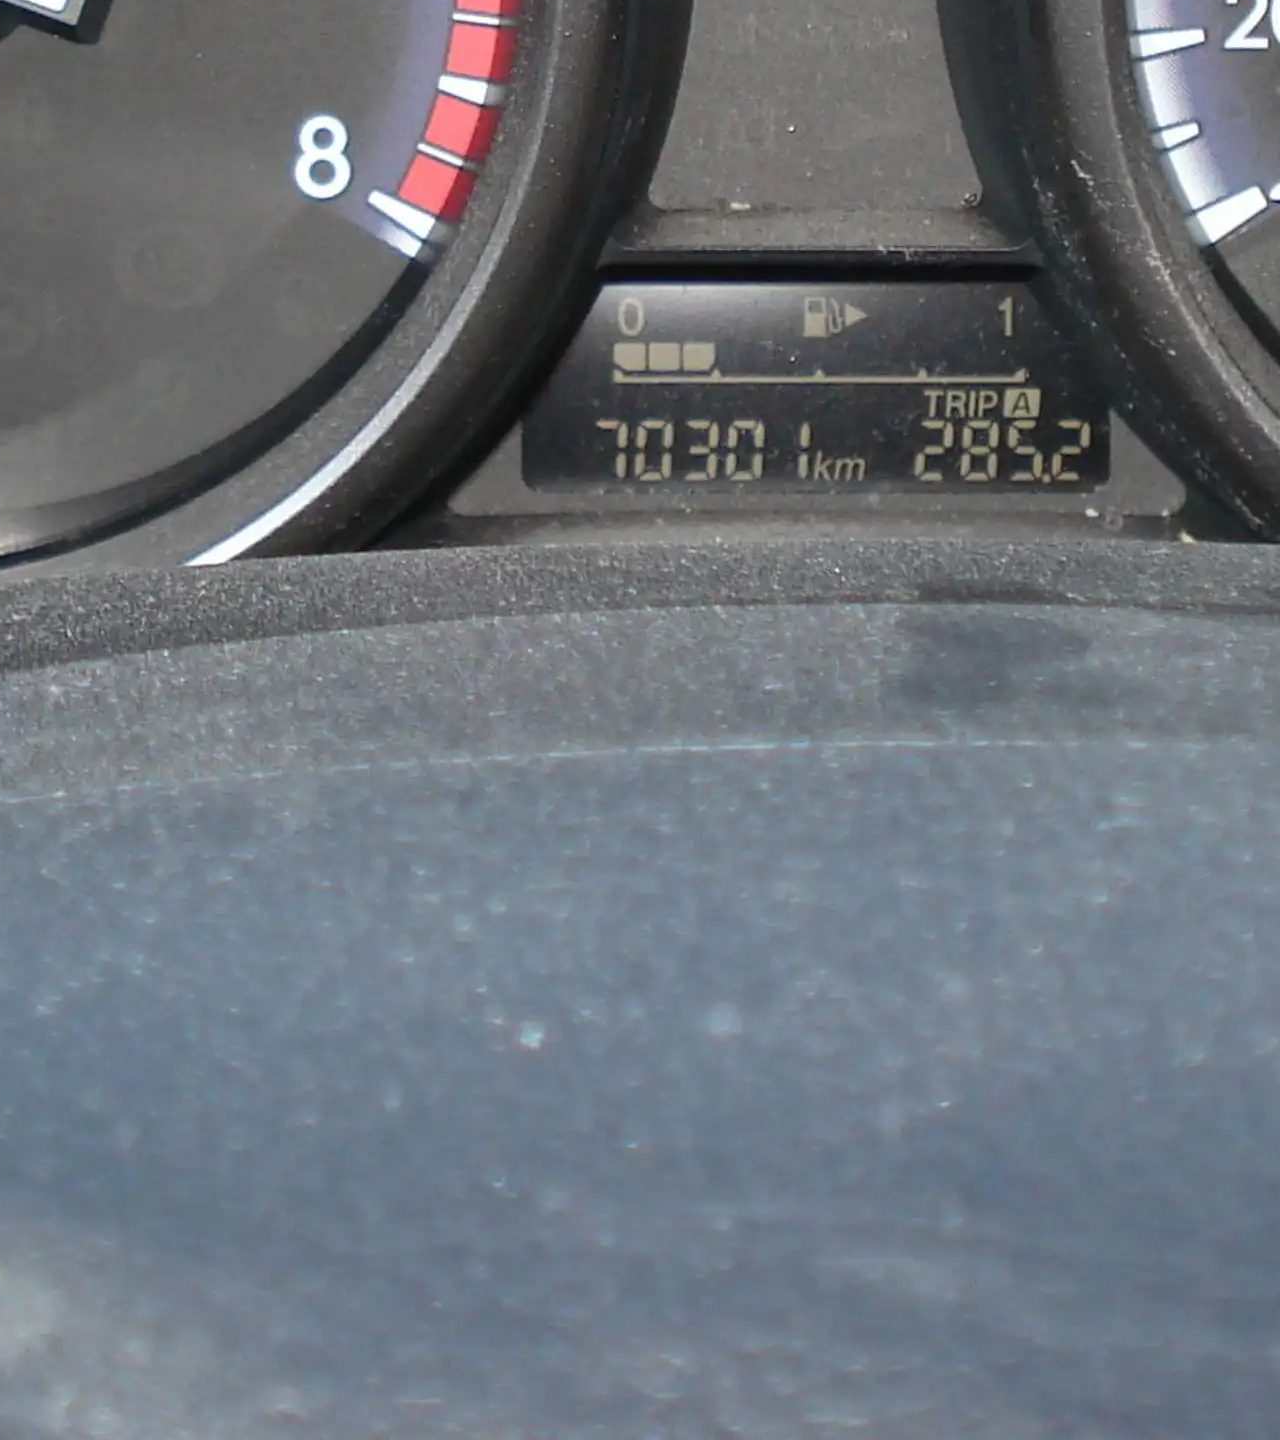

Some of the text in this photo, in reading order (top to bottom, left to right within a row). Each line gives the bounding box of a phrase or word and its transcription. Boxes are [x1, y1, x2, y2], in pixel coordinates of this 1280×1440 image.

[294, 115, 351, 199] 8
[617, 299, 647, 337] 0
[997, 296, 1013, 337] 1
[923, 388, 1035, 419] TRIP A
[812, 449, 867, 483] km
[914, 419, 1091, 484] 285.2
